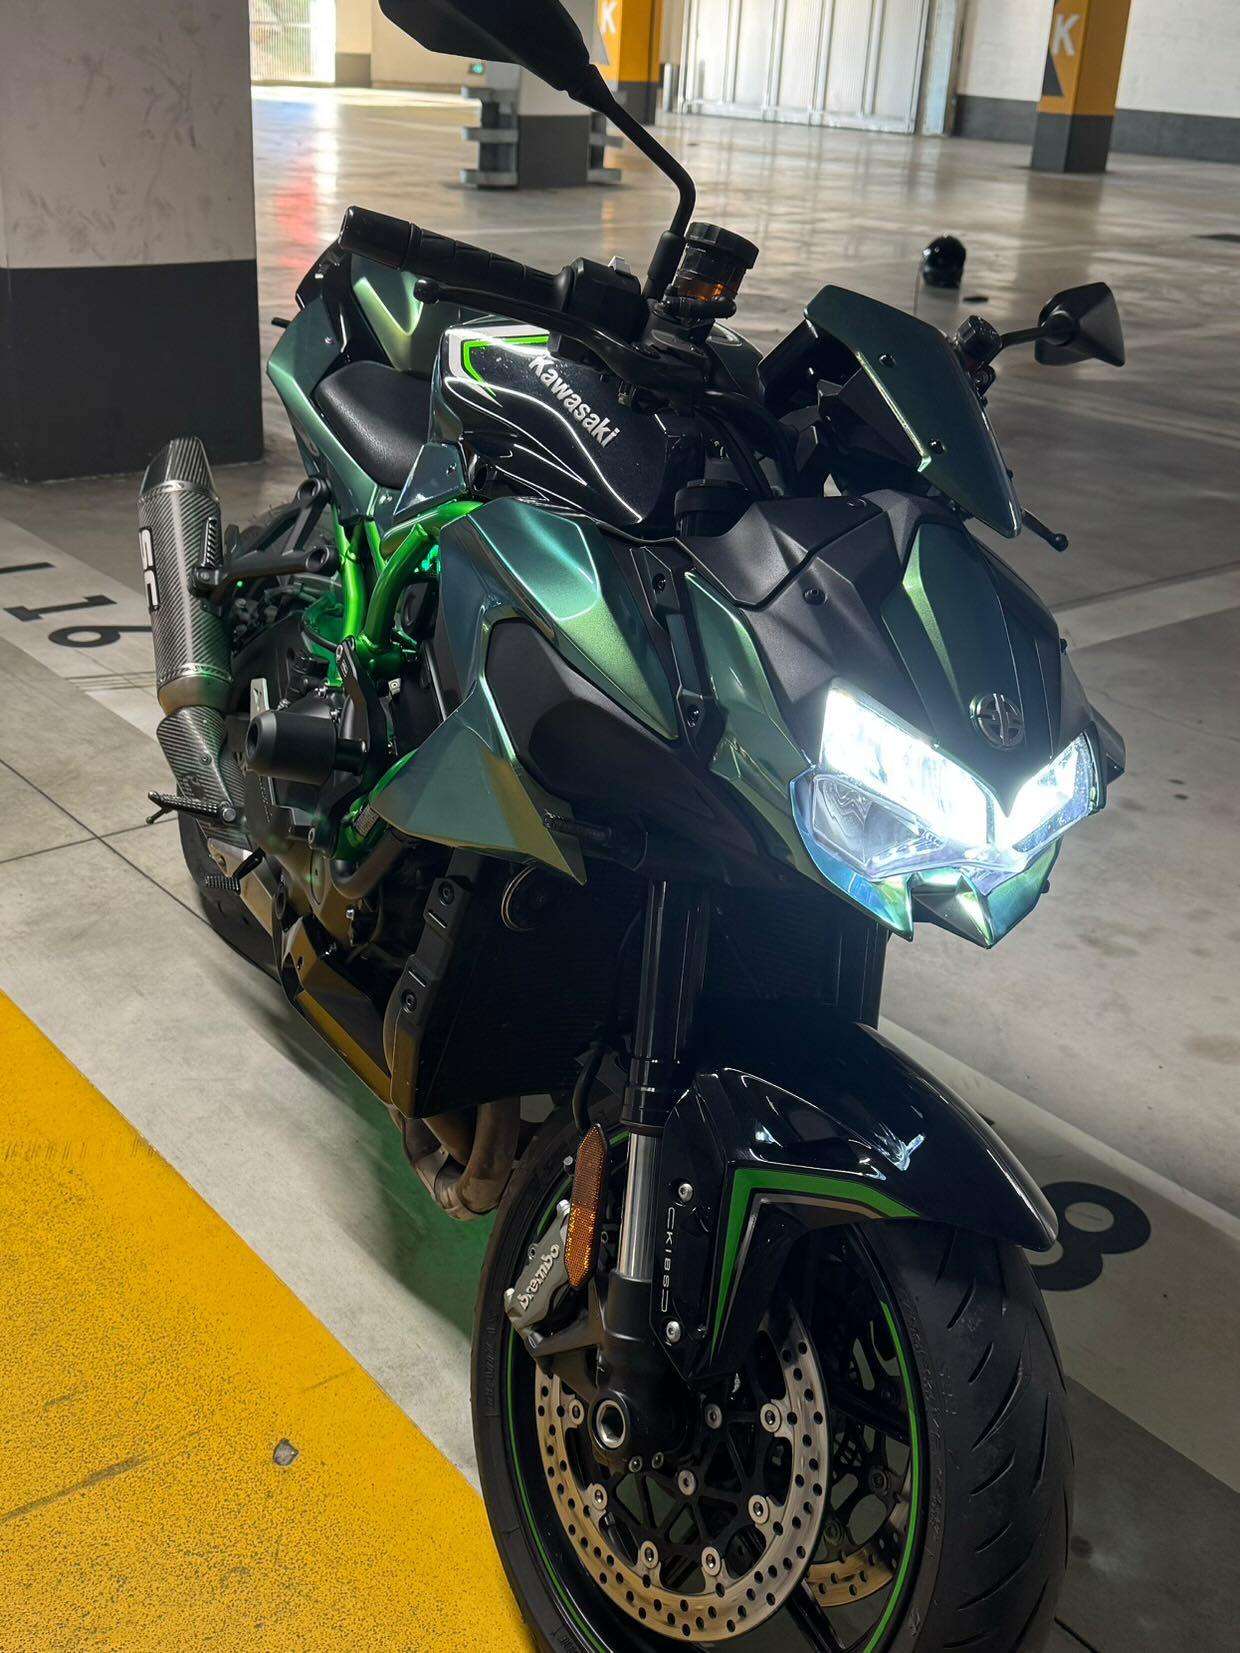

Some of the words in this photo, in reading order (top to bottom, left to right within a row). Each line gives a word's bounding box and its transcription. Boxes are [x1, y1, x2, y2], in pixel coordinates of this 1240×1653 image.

[601, 0, 617, 33] K
[1053, 13, 1081, 56] K
[528, 355, 620, 448] Kawasaki
[517, 1244, 560, 1310] brembo
